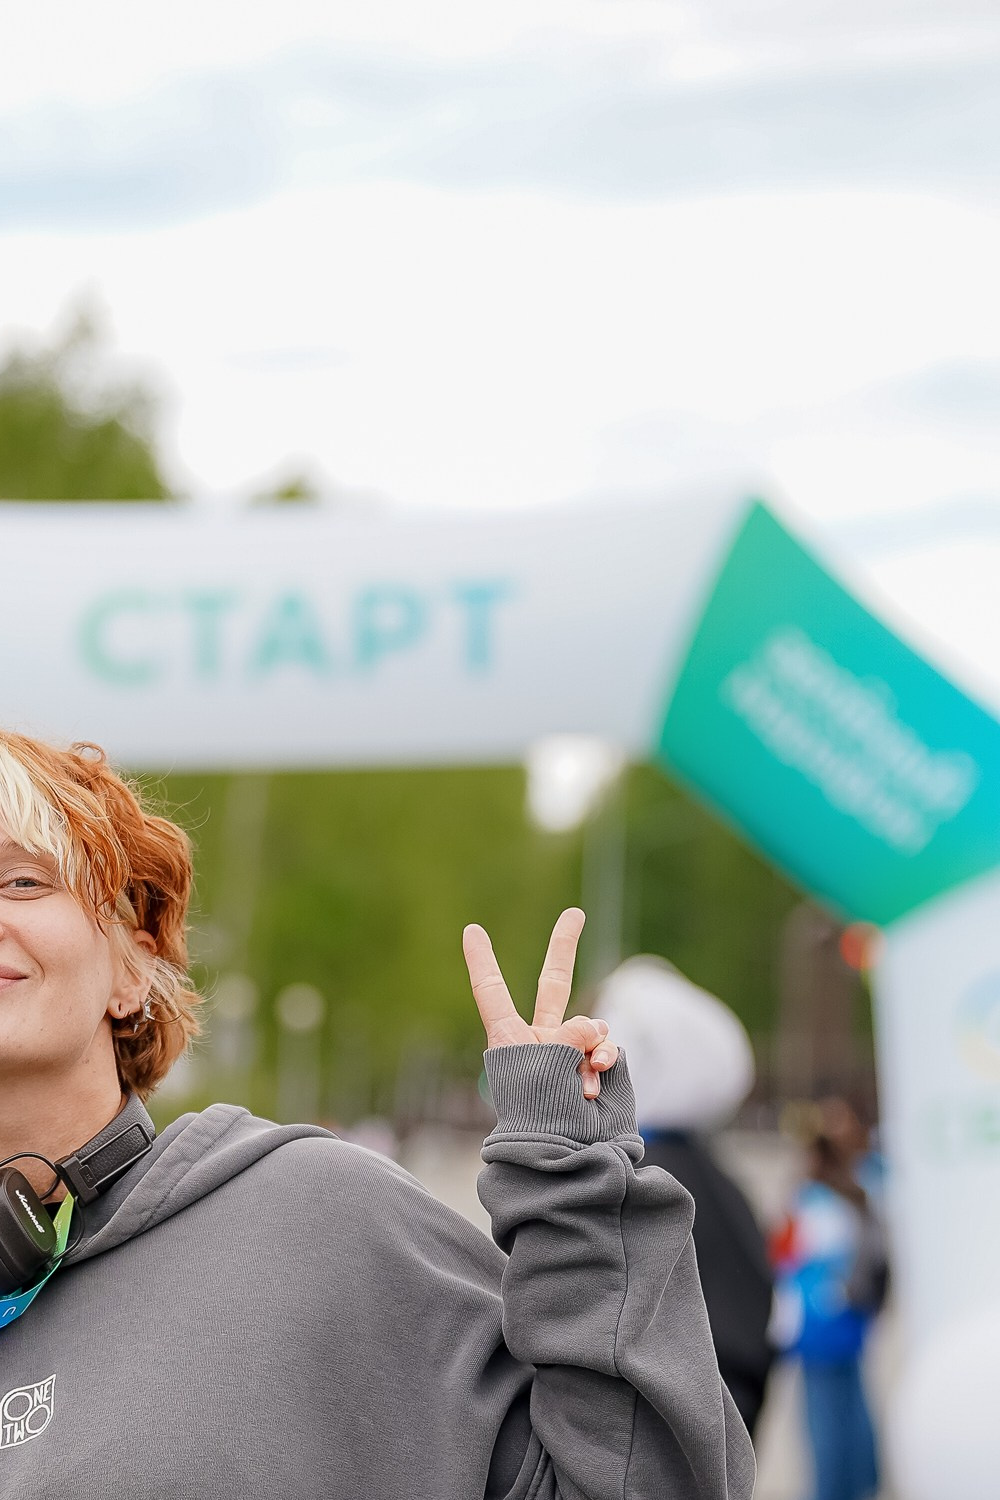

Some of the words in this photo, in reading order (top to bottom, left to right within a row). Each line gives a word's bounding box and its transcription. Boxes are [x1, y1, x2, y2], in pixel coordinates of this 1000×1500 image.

[77, 577, 519, 687] СТАРТ
[3, 1381, 53, 1421] ONE
[2, 1404, 51, 1444] TWO
